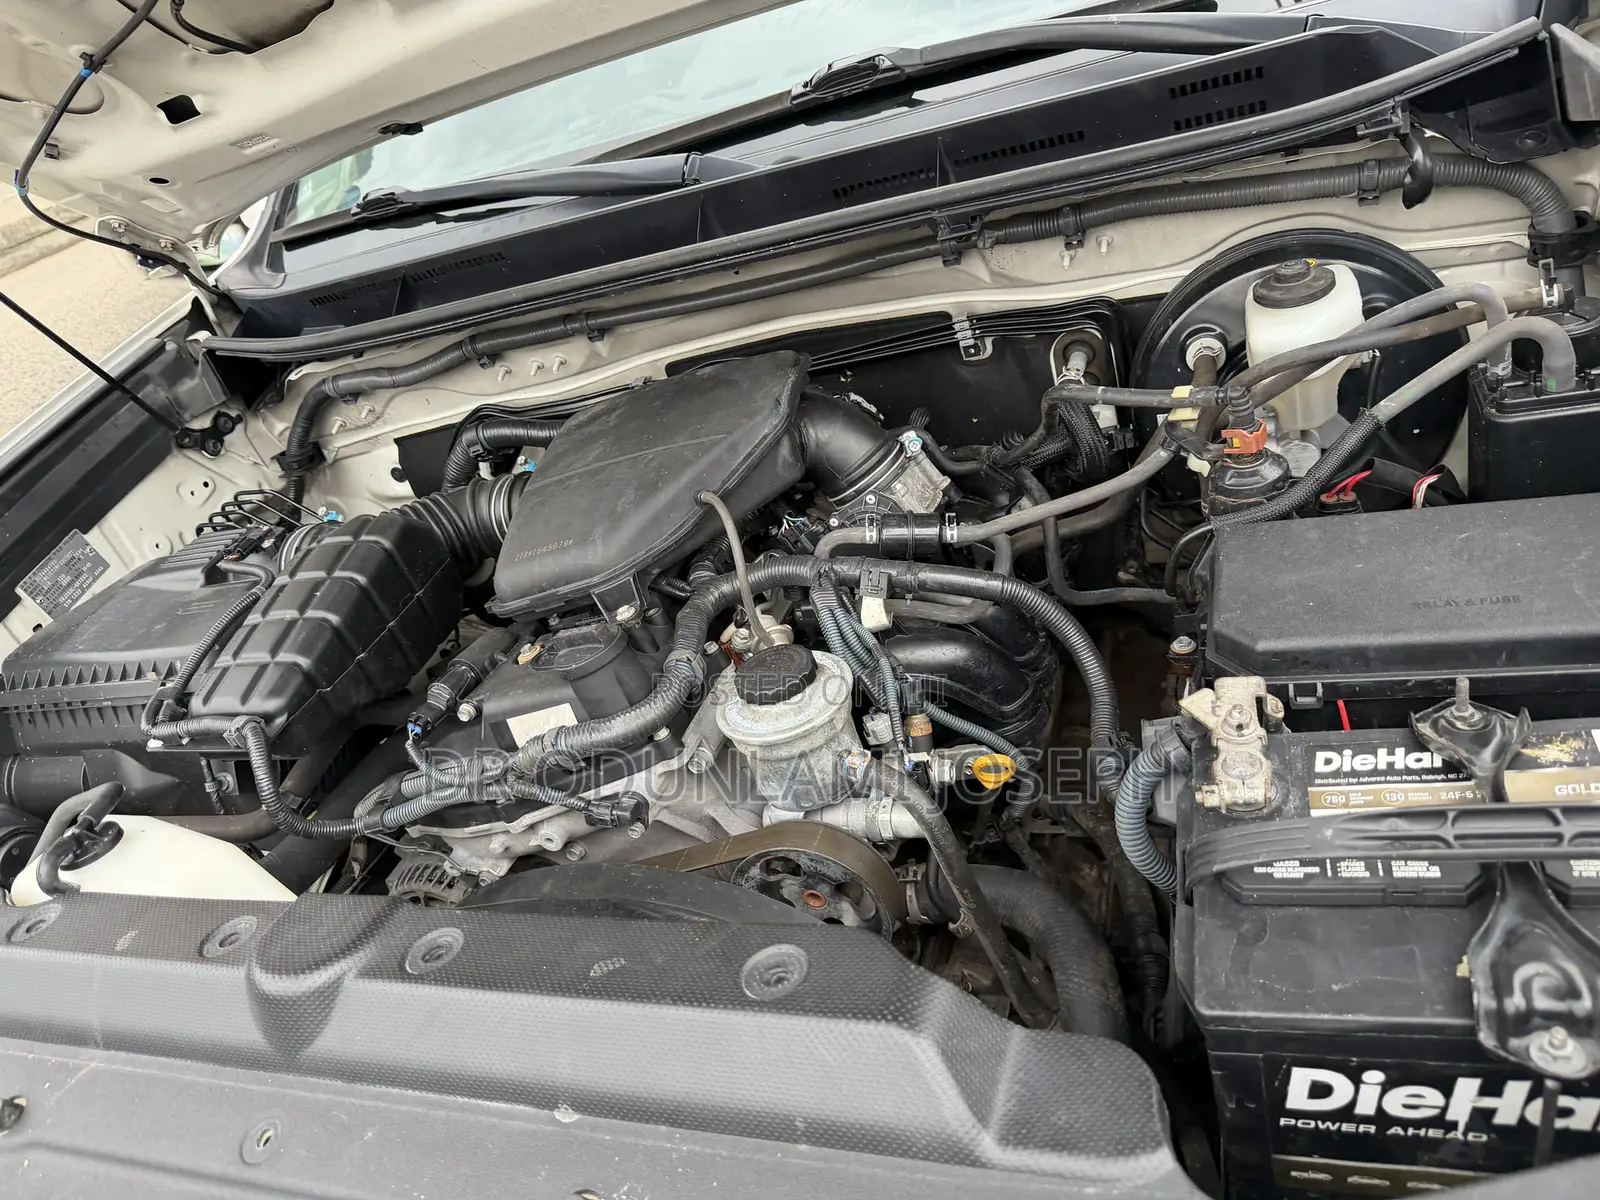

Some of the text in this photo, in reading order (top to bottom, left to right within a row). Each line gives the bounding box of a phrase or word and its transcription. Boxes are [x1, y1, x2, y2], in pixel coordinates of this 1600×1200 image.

[1480, 595, 1522, 606] FUSE
[1314, 747, 1443, 774] DieHar
[1314, 777, 1348, 785] Distributed
[1384, 792, 1405, 801] 130
[1440, 790, 1473, 800] 24F-6
[1554, 782, 1600, 796] GOLD
[1284, 1065, 1600, 1131] DieHa
[1279, 1116, 1489, 1143] POWER AHEAD
